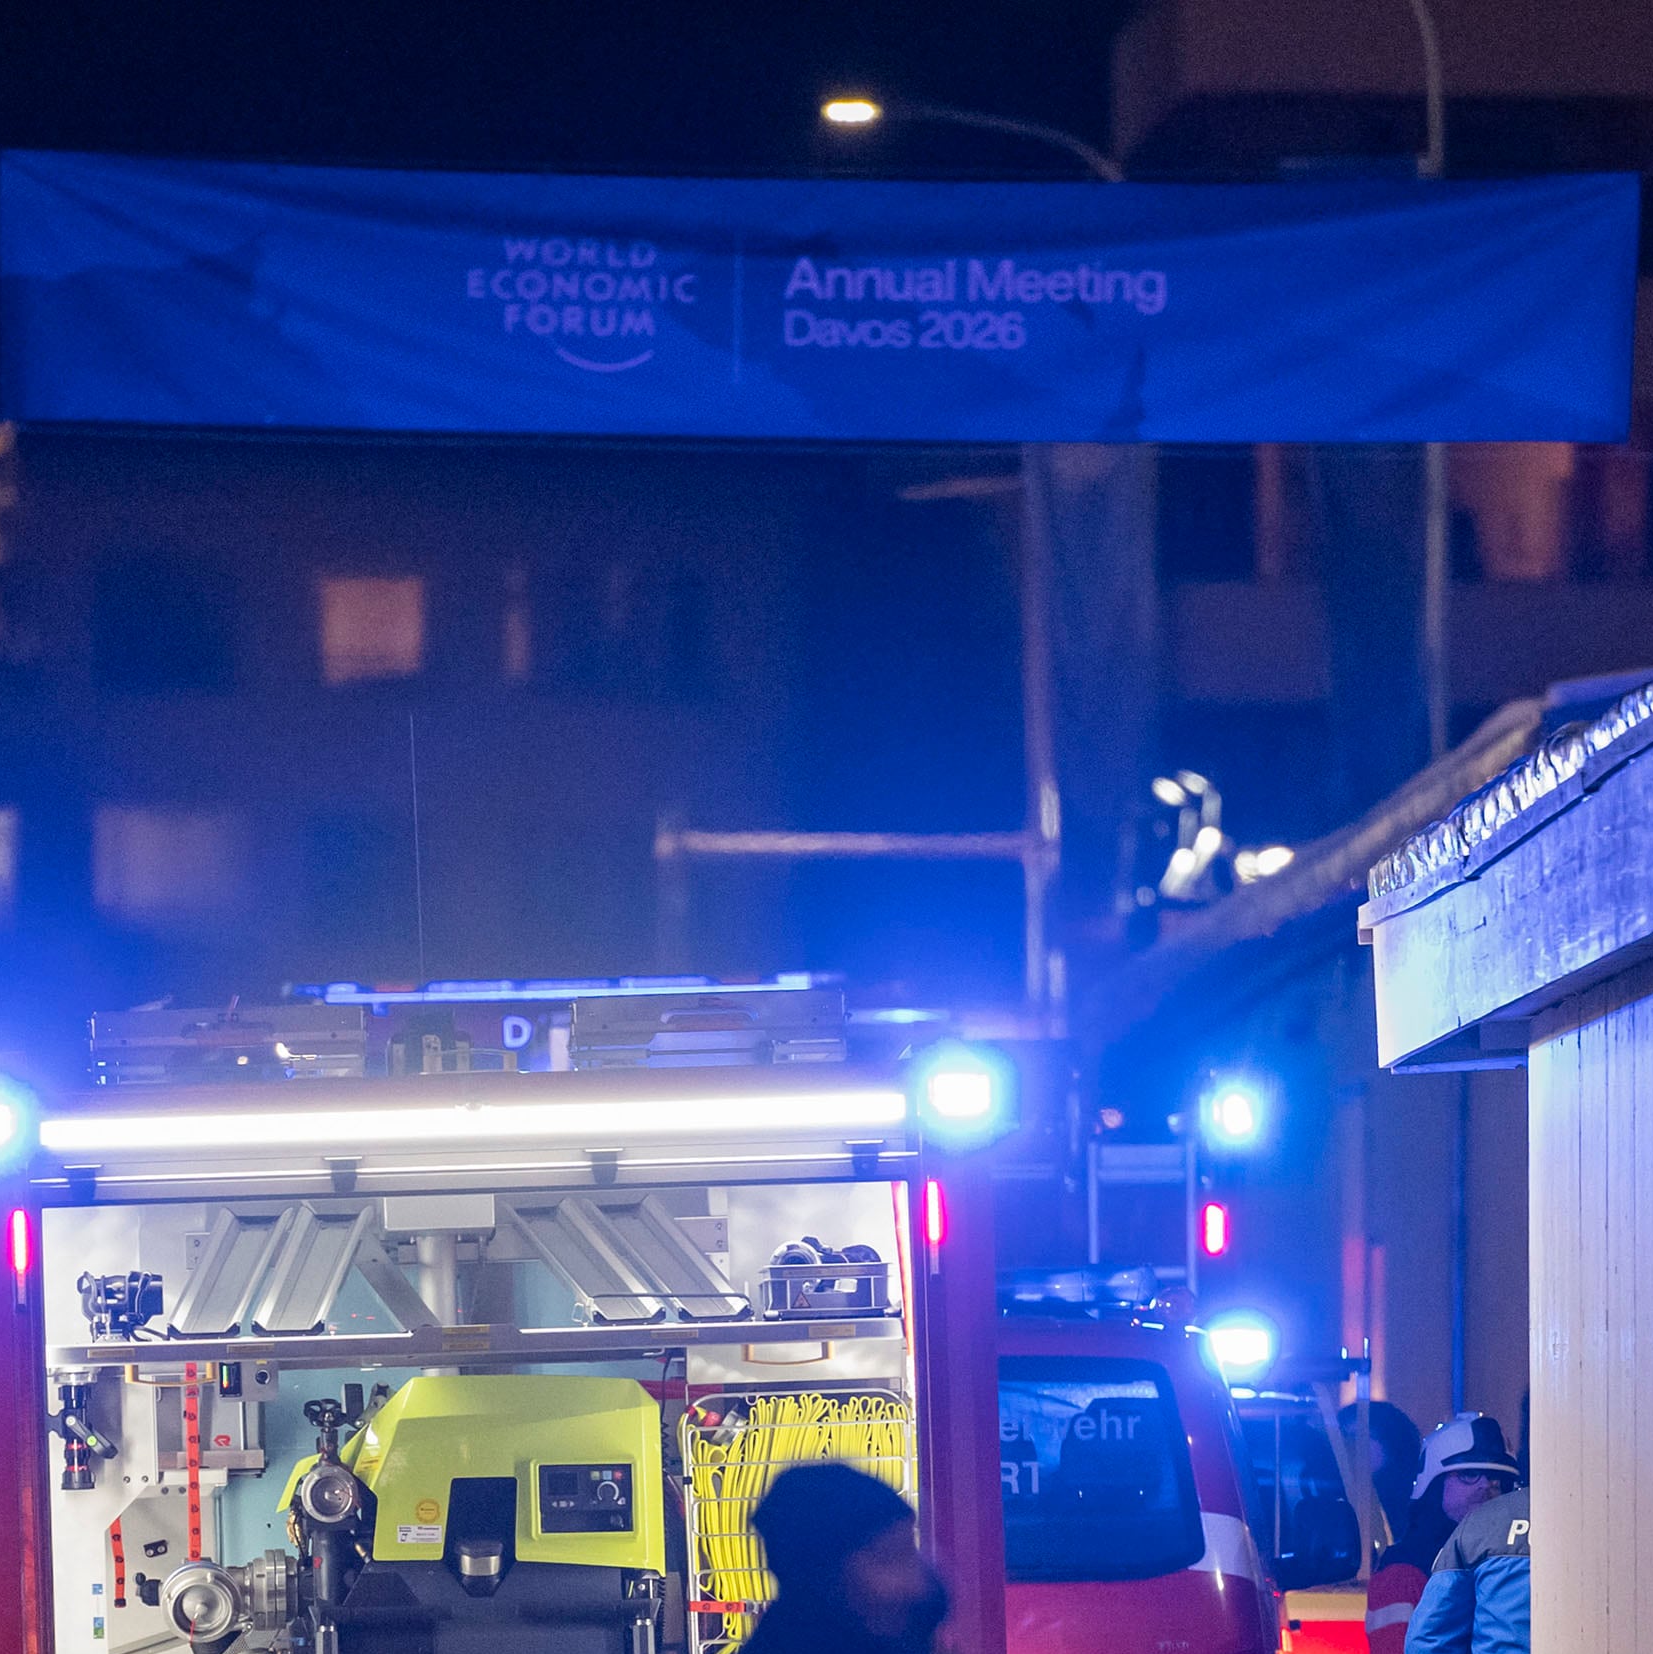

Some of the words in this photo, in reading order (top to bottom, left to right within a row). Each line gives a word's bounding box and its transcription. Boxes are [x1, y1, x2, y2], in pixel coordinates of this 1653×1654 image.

[503, 237, 658, 269] WORLD
[466, 270, 698, 303] ECONOMIC
[783, 256, 959, 302] Annual
[966, 258, 1169, 316] Meeting
[503, 302, 657, 338] FORUM
[783, 309, 914, 348] Davos
[919, 310, 1028, 350] 2026
